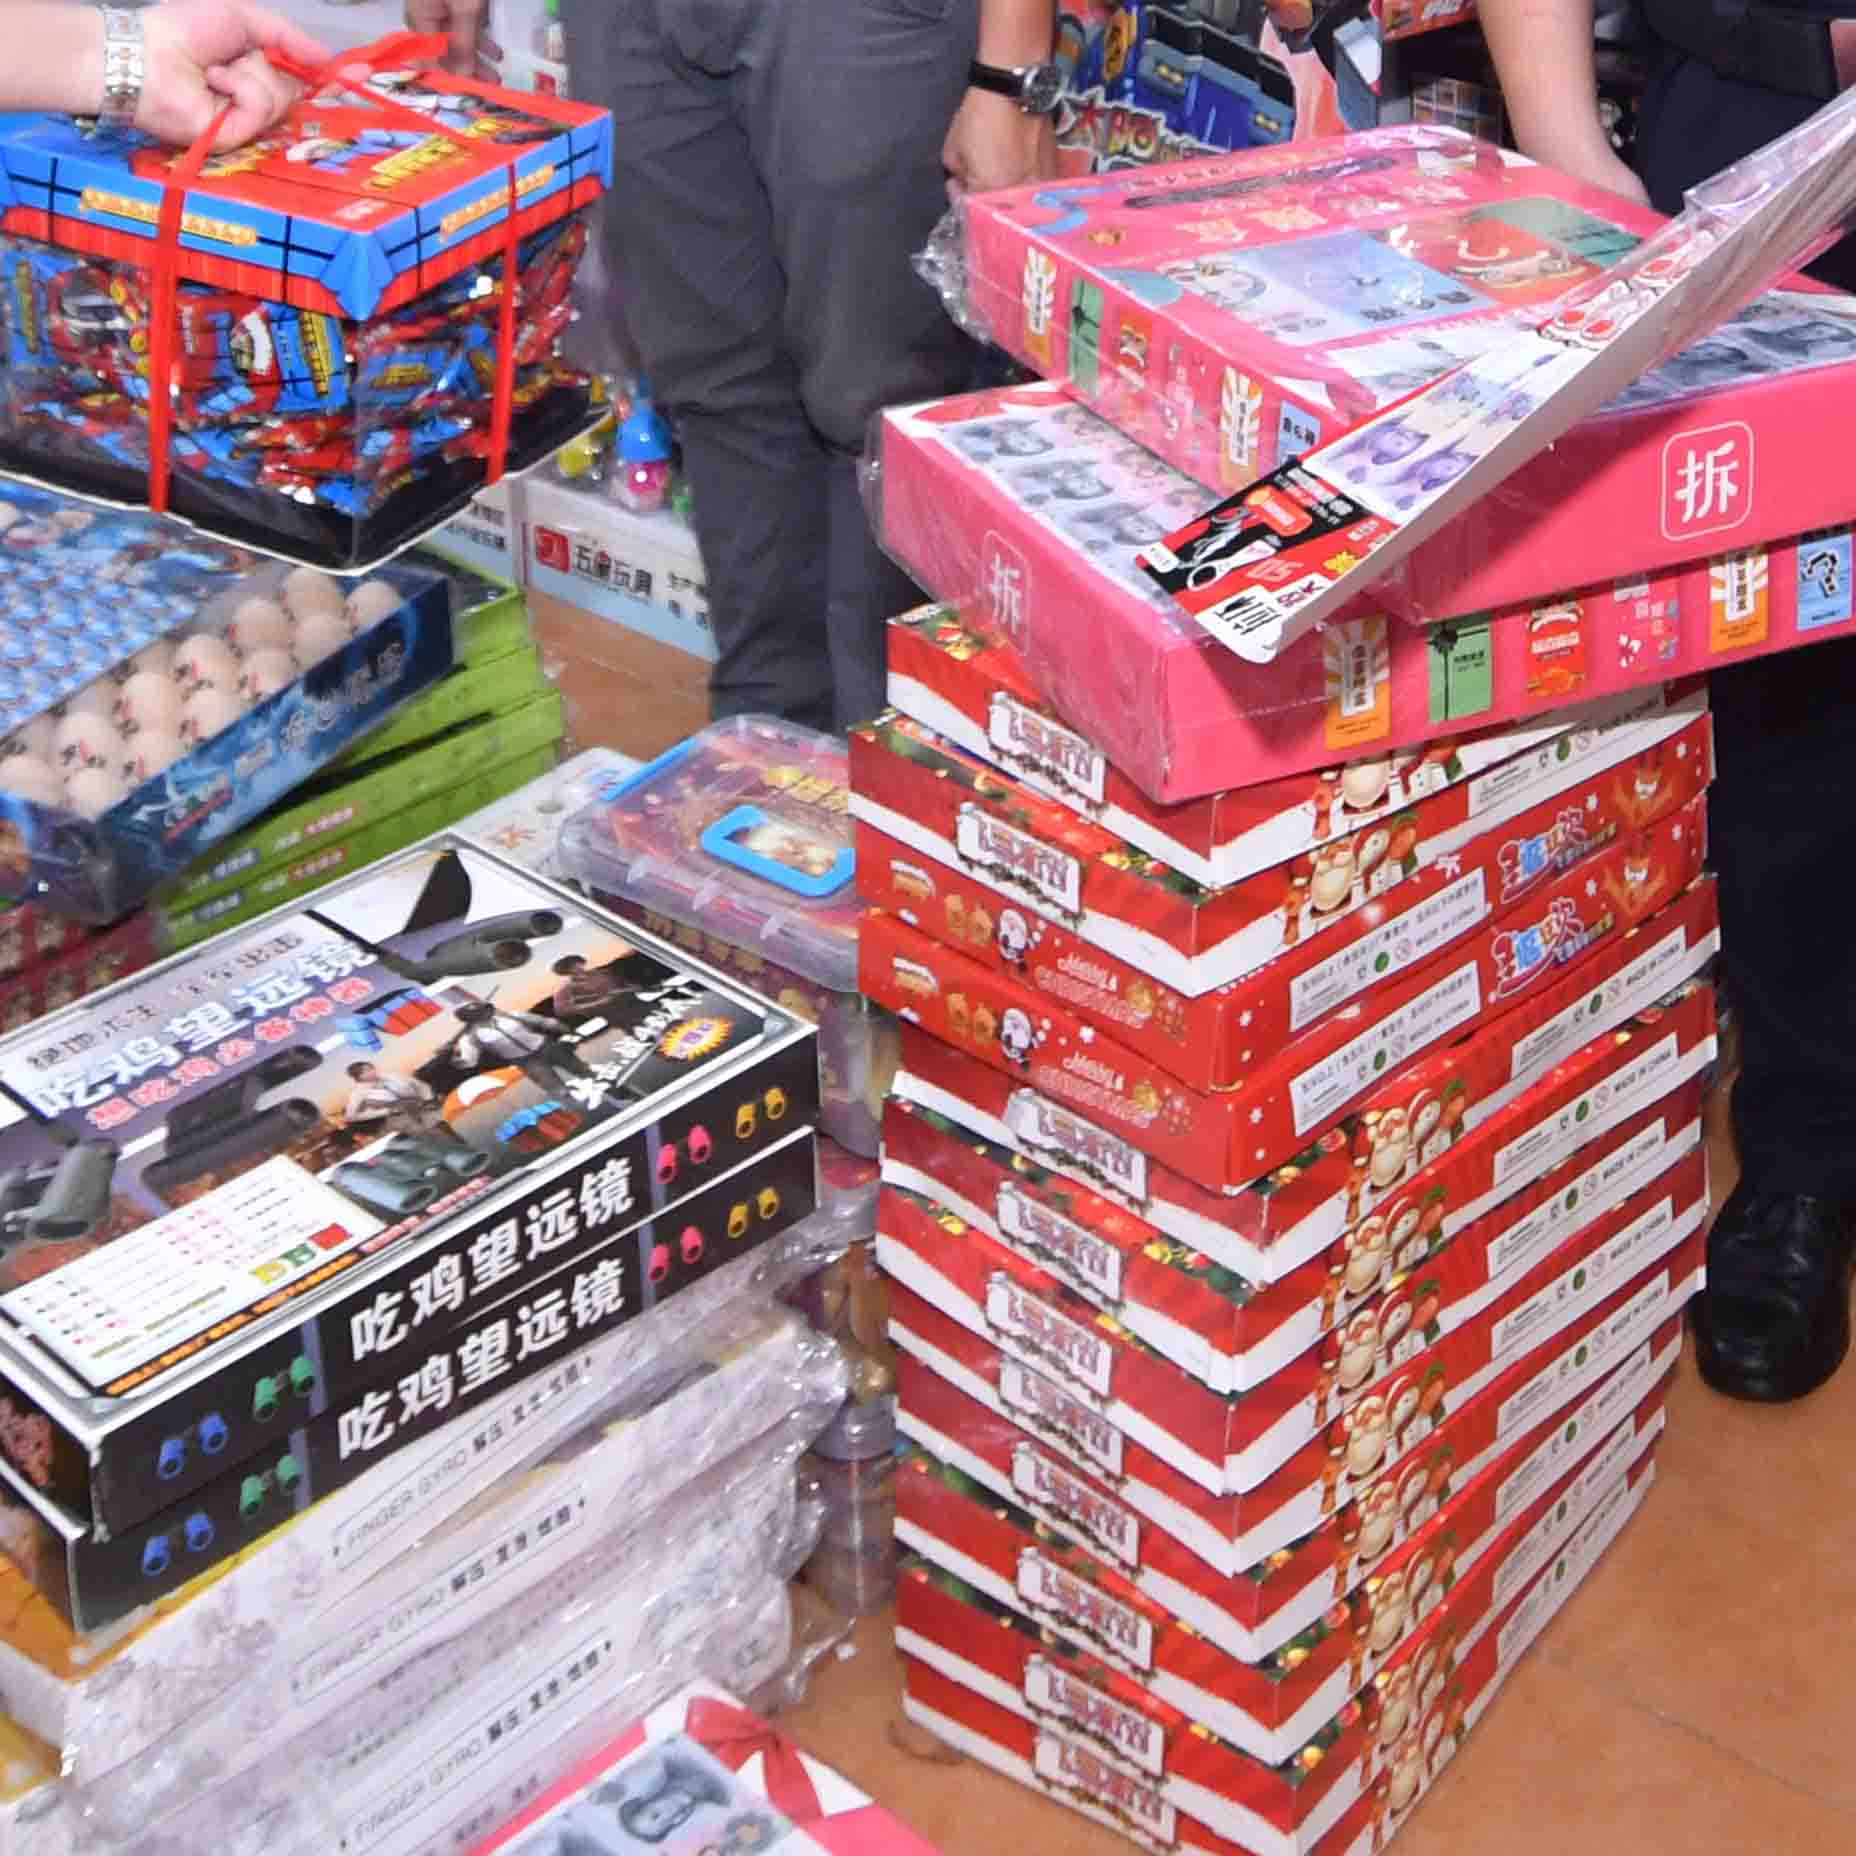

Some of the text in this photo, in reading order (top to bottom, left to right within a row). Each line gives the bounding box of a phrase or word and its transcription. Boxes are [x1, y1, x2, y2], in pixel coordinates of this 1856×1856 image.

[1672, 437, 1739, 524] 拆
[986, 546, 1024, 636] 拆
[36, 941, 380, 1118] 吃鸡望远镜
[350, 1156, 636, 1362] 吃鸡望远镜
[337, 1256, 626, 1460] 吃鸡望远镜
